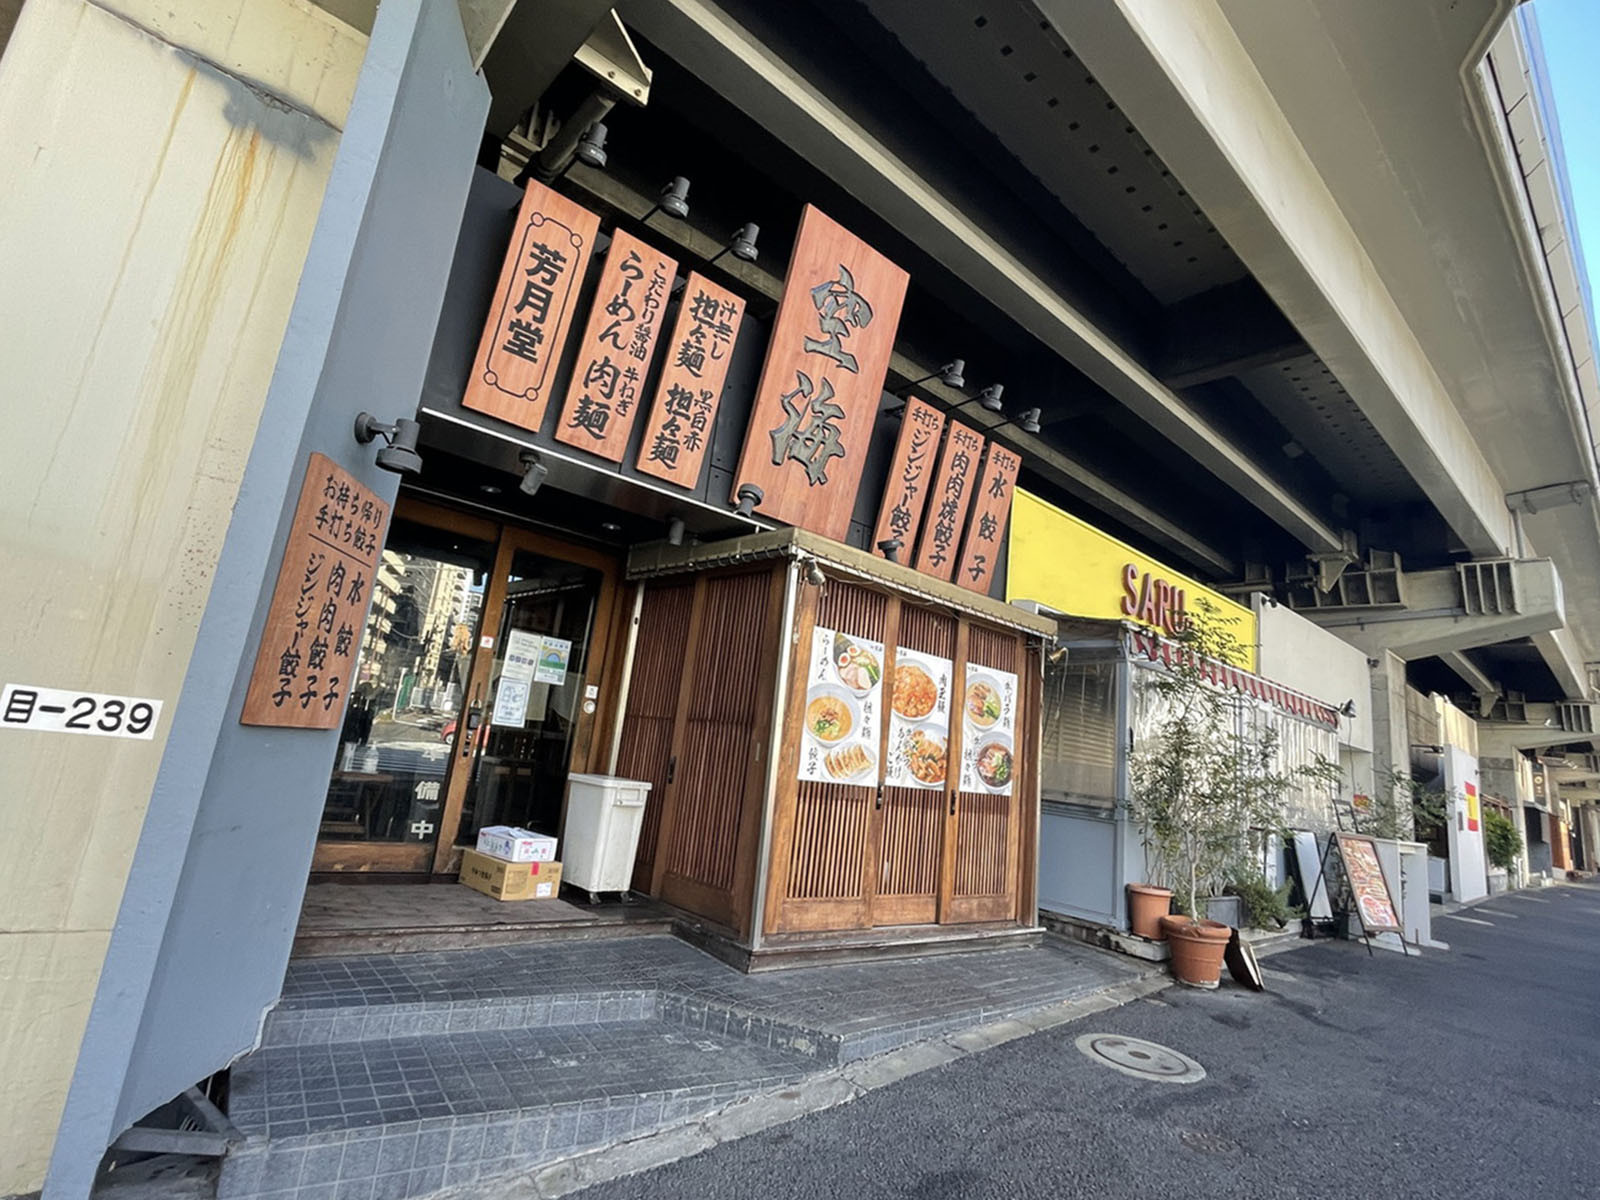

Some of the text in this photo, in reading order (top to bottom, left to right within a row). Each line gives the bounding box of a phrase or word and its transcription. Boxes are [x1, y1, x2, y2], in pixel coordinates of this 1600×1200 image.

[502, 241, 567, 364] 芳月堂
[568, 250, 645, 440] らーめん 肉麺
[628, 261, 666, 362] こだわり醤油
[647, 290, 721, 470] 担々麺 担々麺
[769, 263, 875, 486] 空海
[315, 503, 376, 557] 手打ち餃子
[323, 474, 382, 529] お持ち帰り
[968, 471, 1007, 582] 水餃子
[272, 552, 325, 707] ジンジャー餃子
[299, 560, 346, 709] 肉肉餃子
[323, 571, 366, 711] 水餃子
